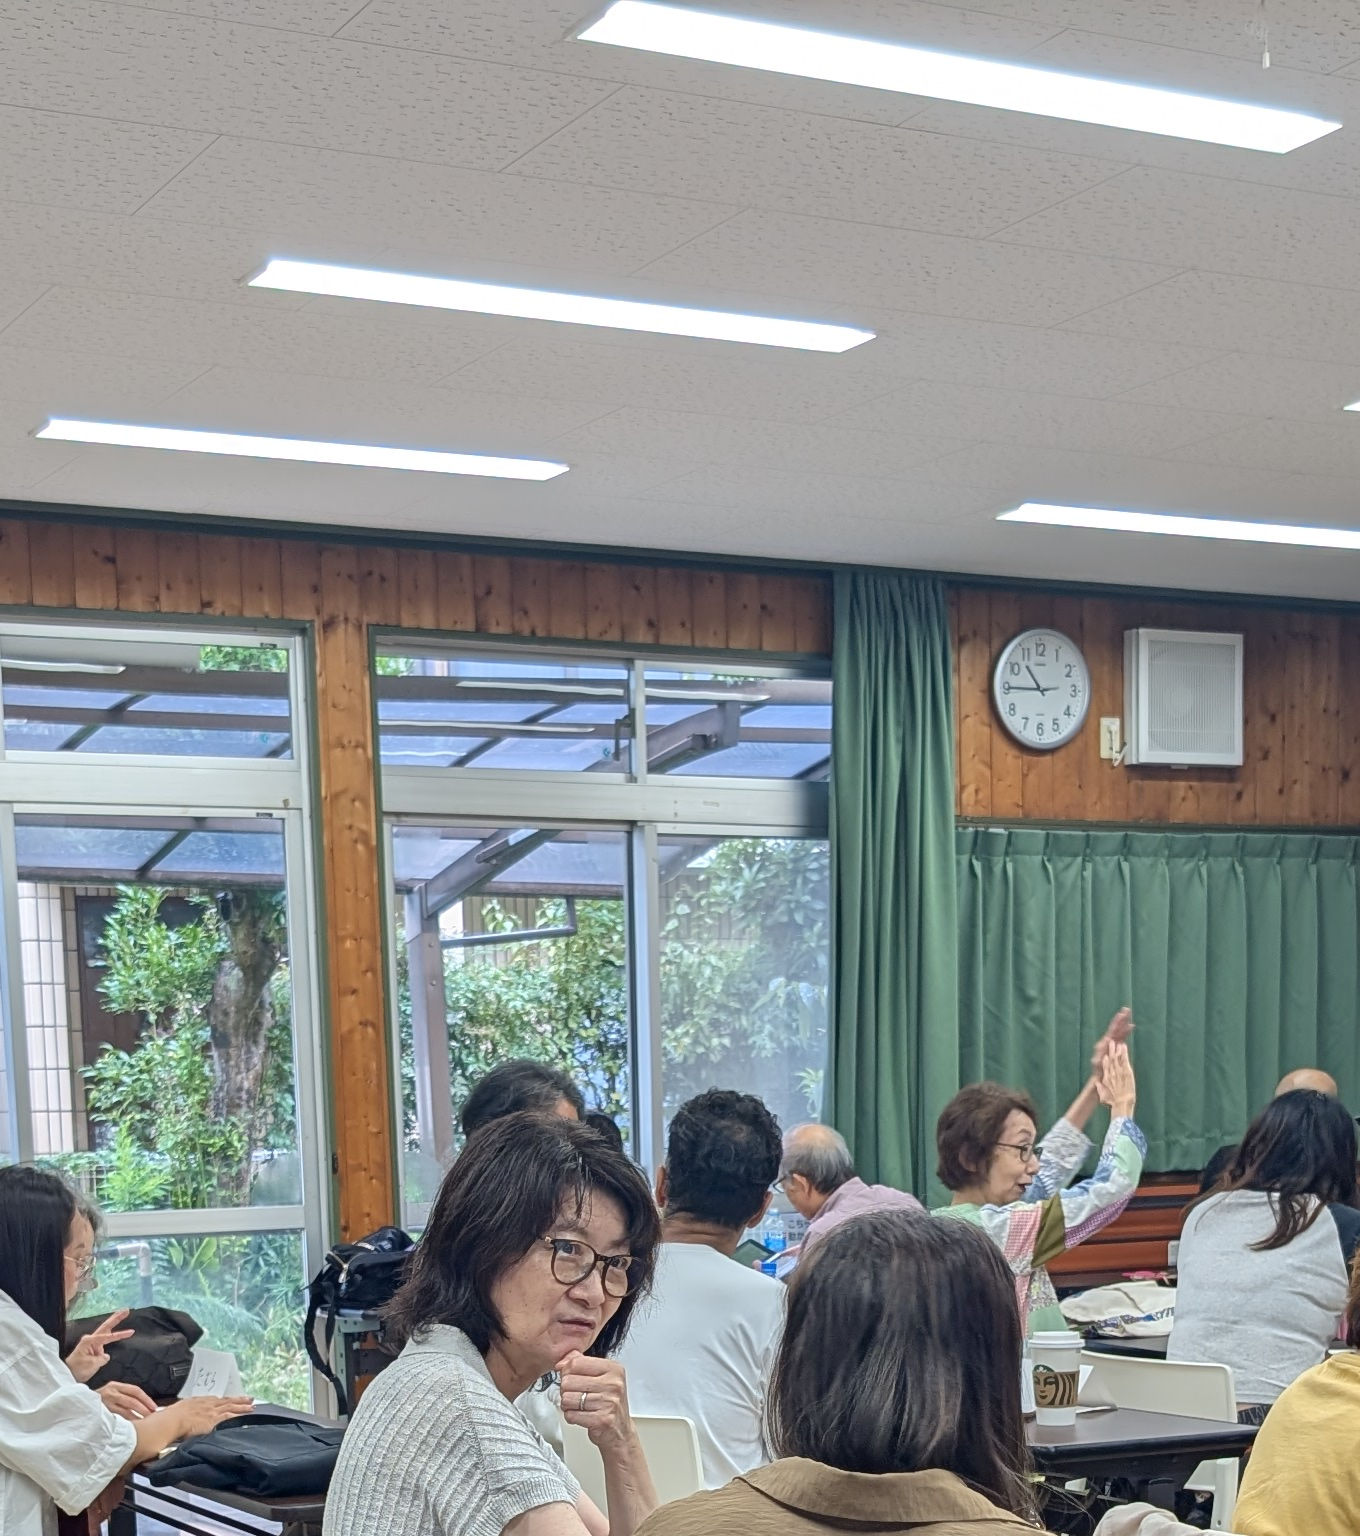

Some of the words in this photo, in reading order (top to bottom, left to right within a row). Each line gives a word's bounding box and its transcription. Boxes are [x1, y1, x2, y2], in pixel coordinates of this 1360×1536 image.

[1022, 647, 1030, 661] 11
[1035, 643, 1046, 657] 12
[1009, 661, 1020, 676] 10
[1064, 663, 1072, 678] 2
[1003, 681, 1010, 695] 9
[1070, 684, 1077, 698] 3
[1008, 702, 1016, 717] 8
[1063, 705, 1071, 718] 4
[1021, 716, 1030, 731] 7
[1036, 722, 1044, 737] 6
[1052, 718, 1060, 732] 5
